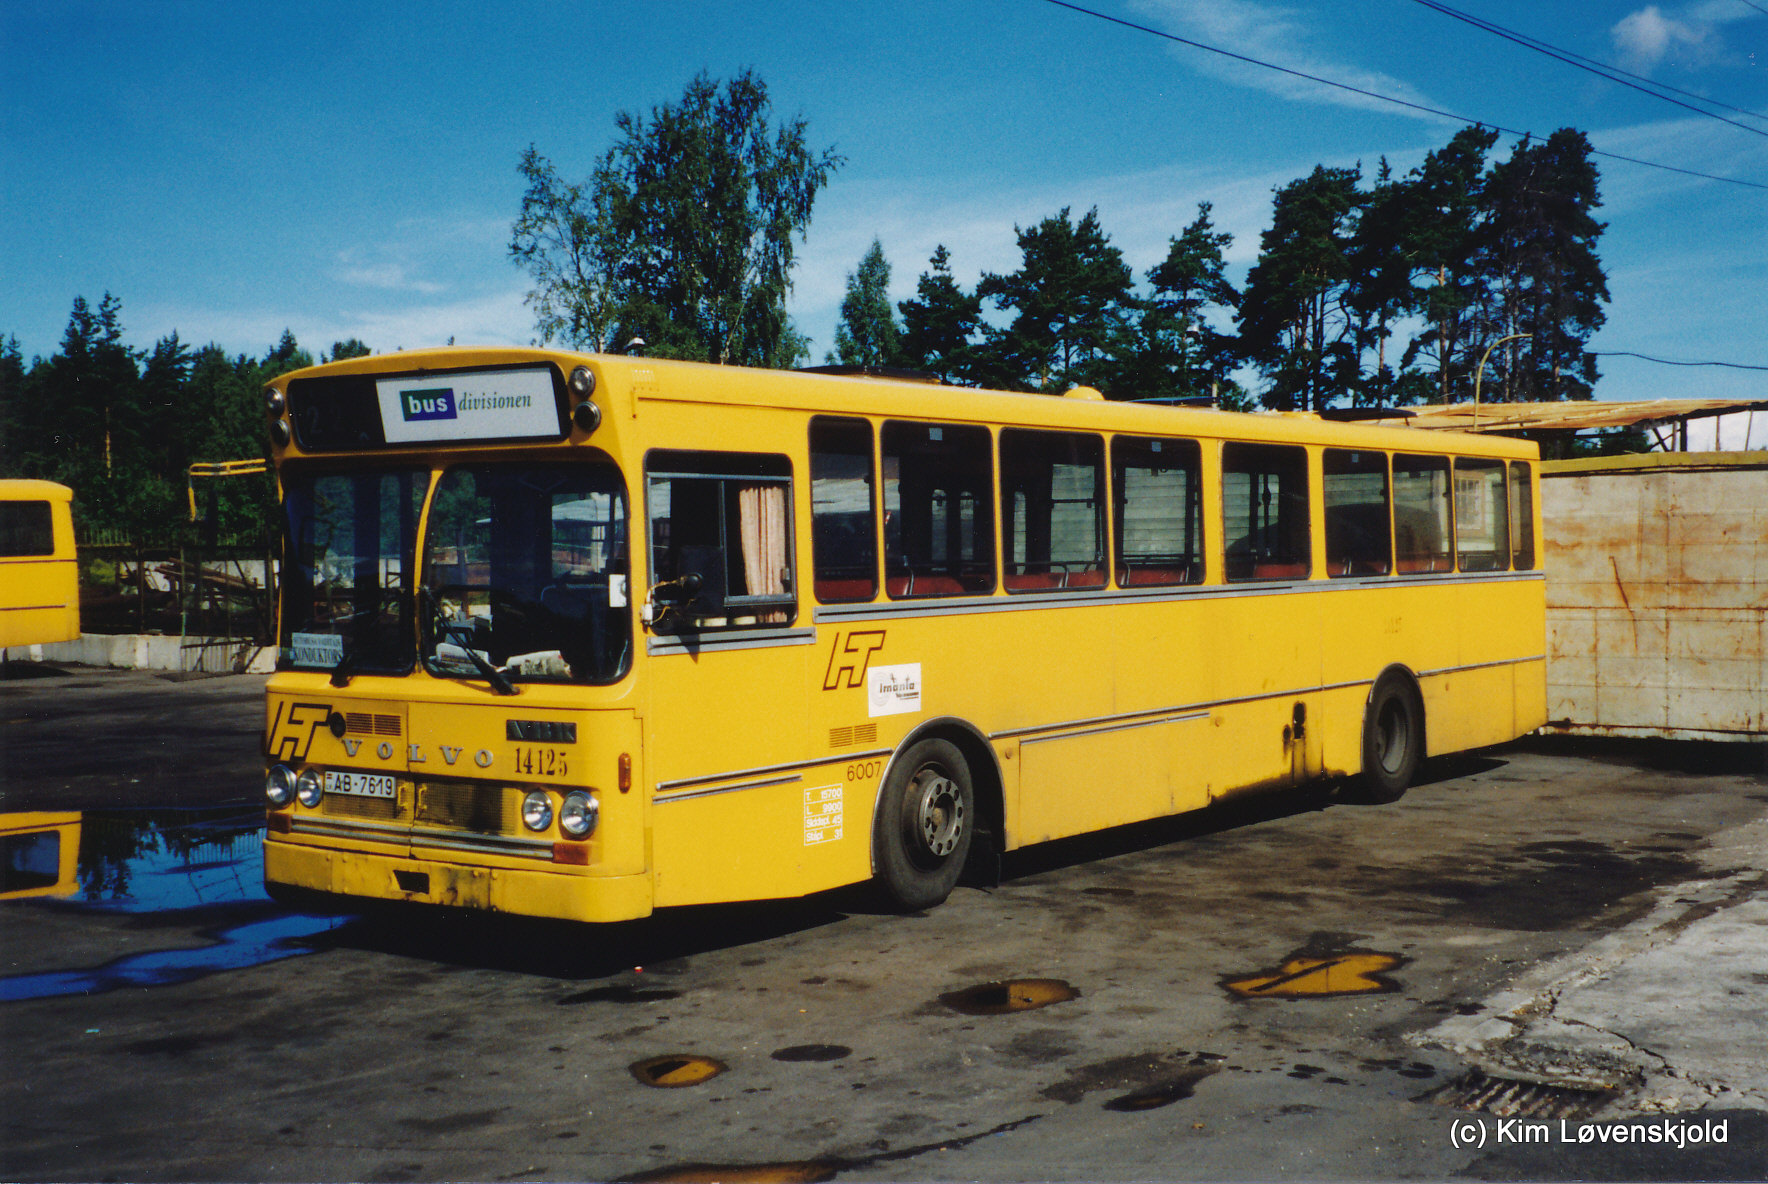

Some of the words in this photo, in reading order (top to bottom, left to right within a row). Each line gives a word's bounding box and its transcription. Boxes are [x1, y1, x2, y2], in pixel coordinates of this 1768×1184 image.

[408, 396, 448, 414] bus
[458, 391, 532, 411] divisionen
[822, 630, 887, 691] HT
[267, 701, 333, 762] HT
[341, 738, 494, 768] VOLVO
[515, 747, 568, 777] 14125
[847, 761, 881, 781] 6007
